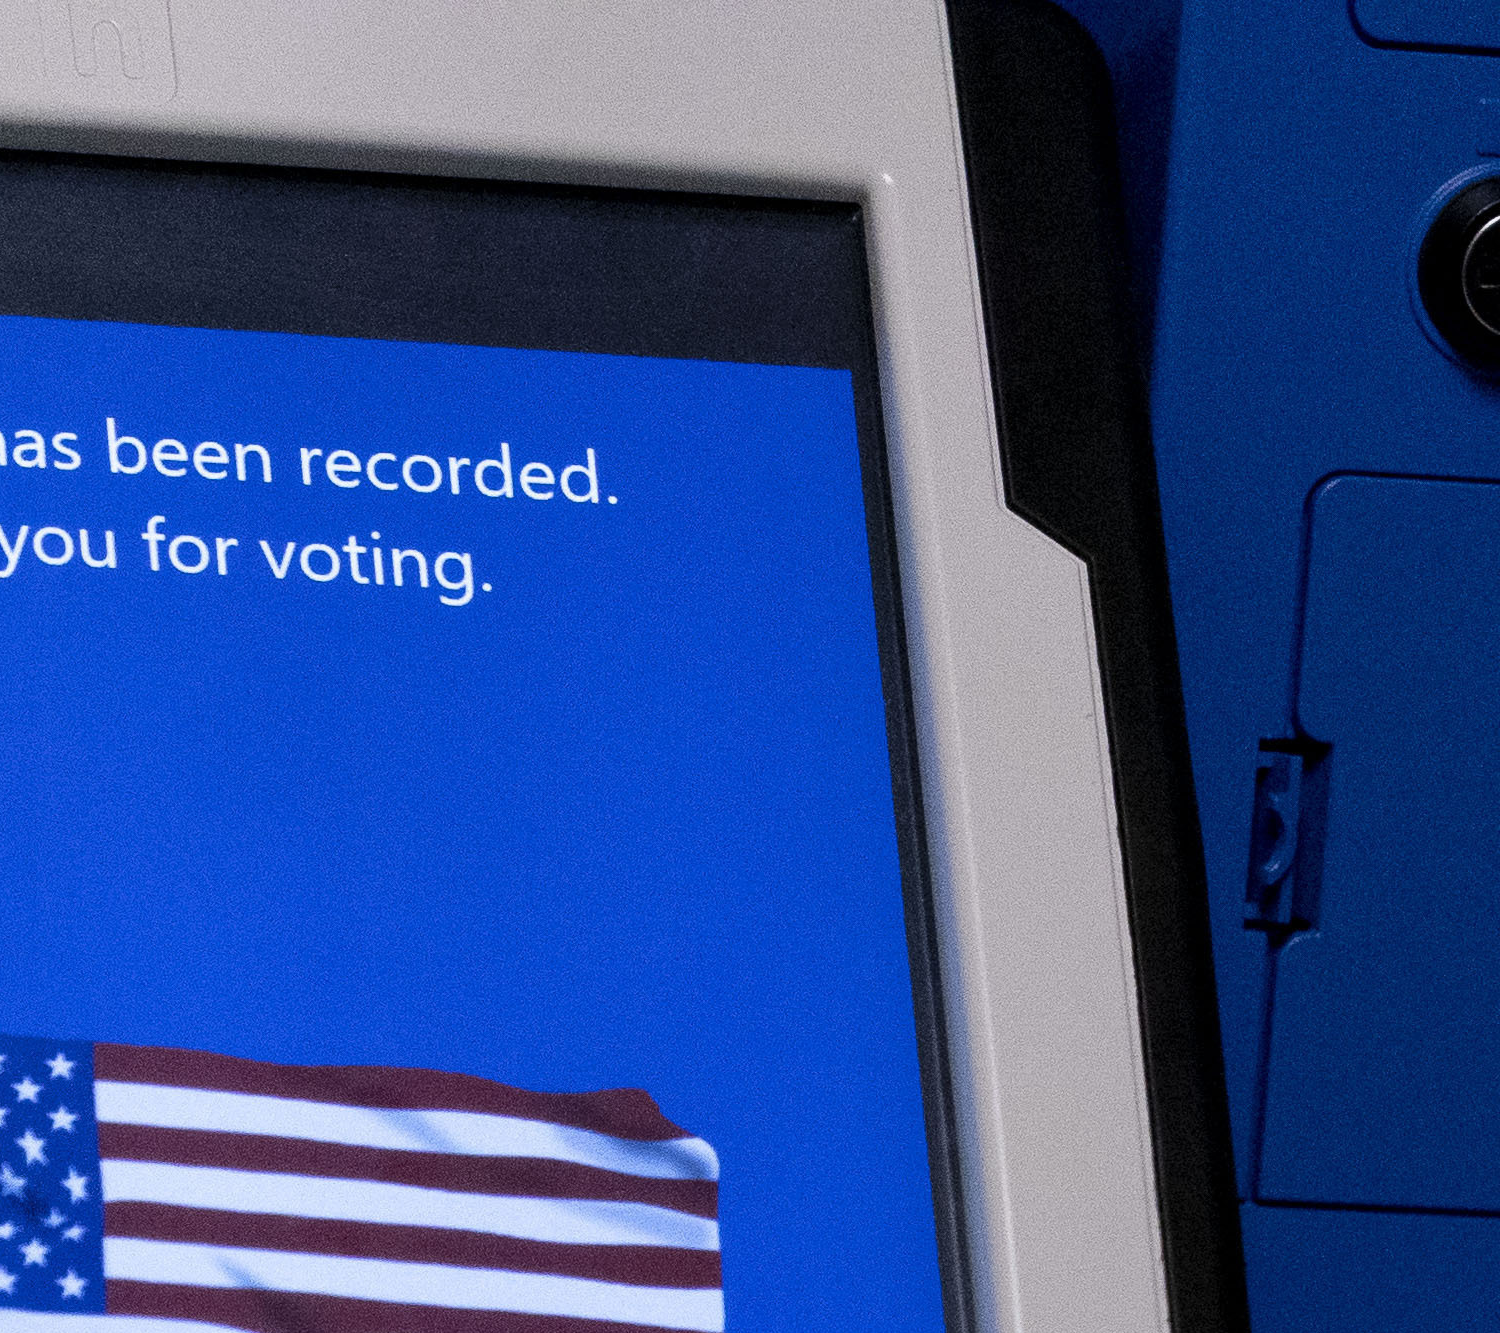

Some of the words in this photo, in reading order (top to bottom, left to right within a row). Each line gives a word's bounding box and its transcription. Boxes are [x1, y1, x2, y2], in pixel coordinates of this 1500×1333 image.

[105, 416, 273, 484] been
[299, 441, 620, 506] recorded.
[140, 514, 239, 577] for
[258, 530, 493, 607] voting.
